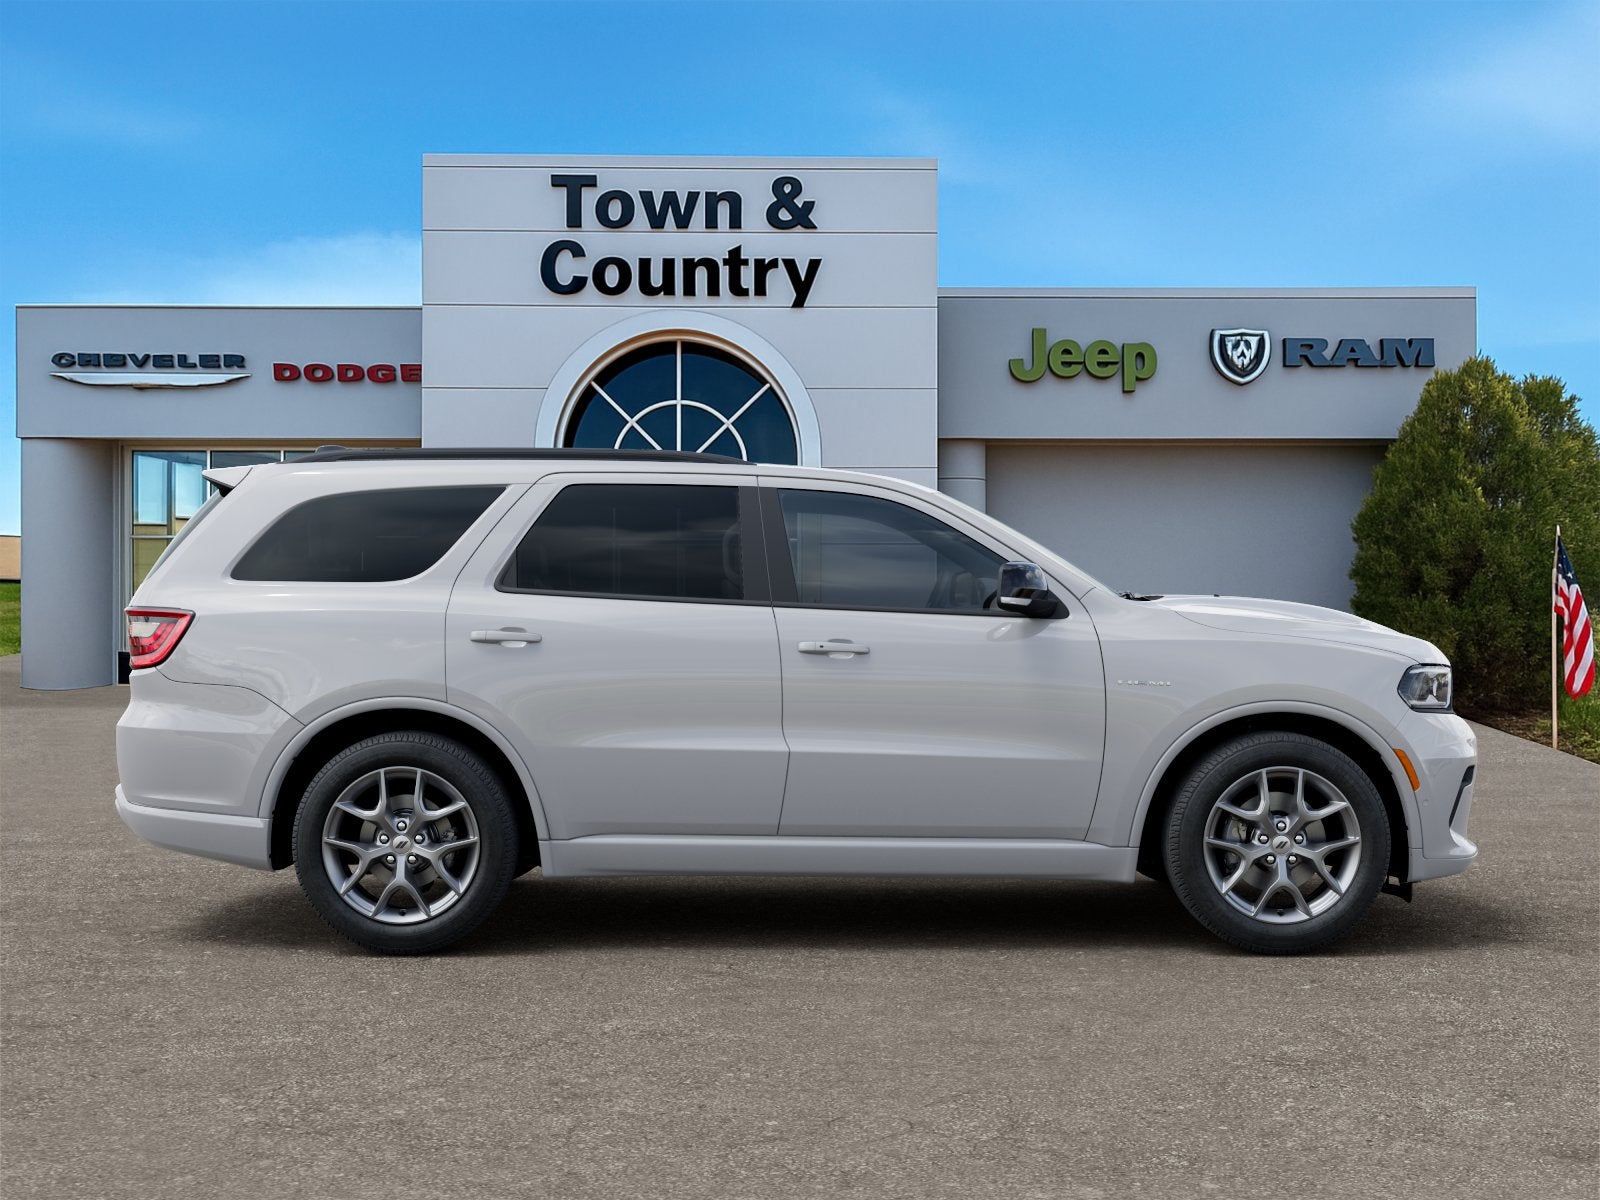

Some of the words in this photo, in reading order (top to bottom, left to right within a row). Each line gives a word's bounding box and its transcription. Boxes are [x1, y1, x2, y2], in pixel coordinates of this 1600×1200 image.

[550, 174, 742, 229] Town
[765, 176, 818, 230] &
[540, 239, 822, 308] Country
[273, 363, 422, 383] DODGE
[1009, 327, 1158, 393] Jeep
[1282, 337, 1436, 368] RAM
